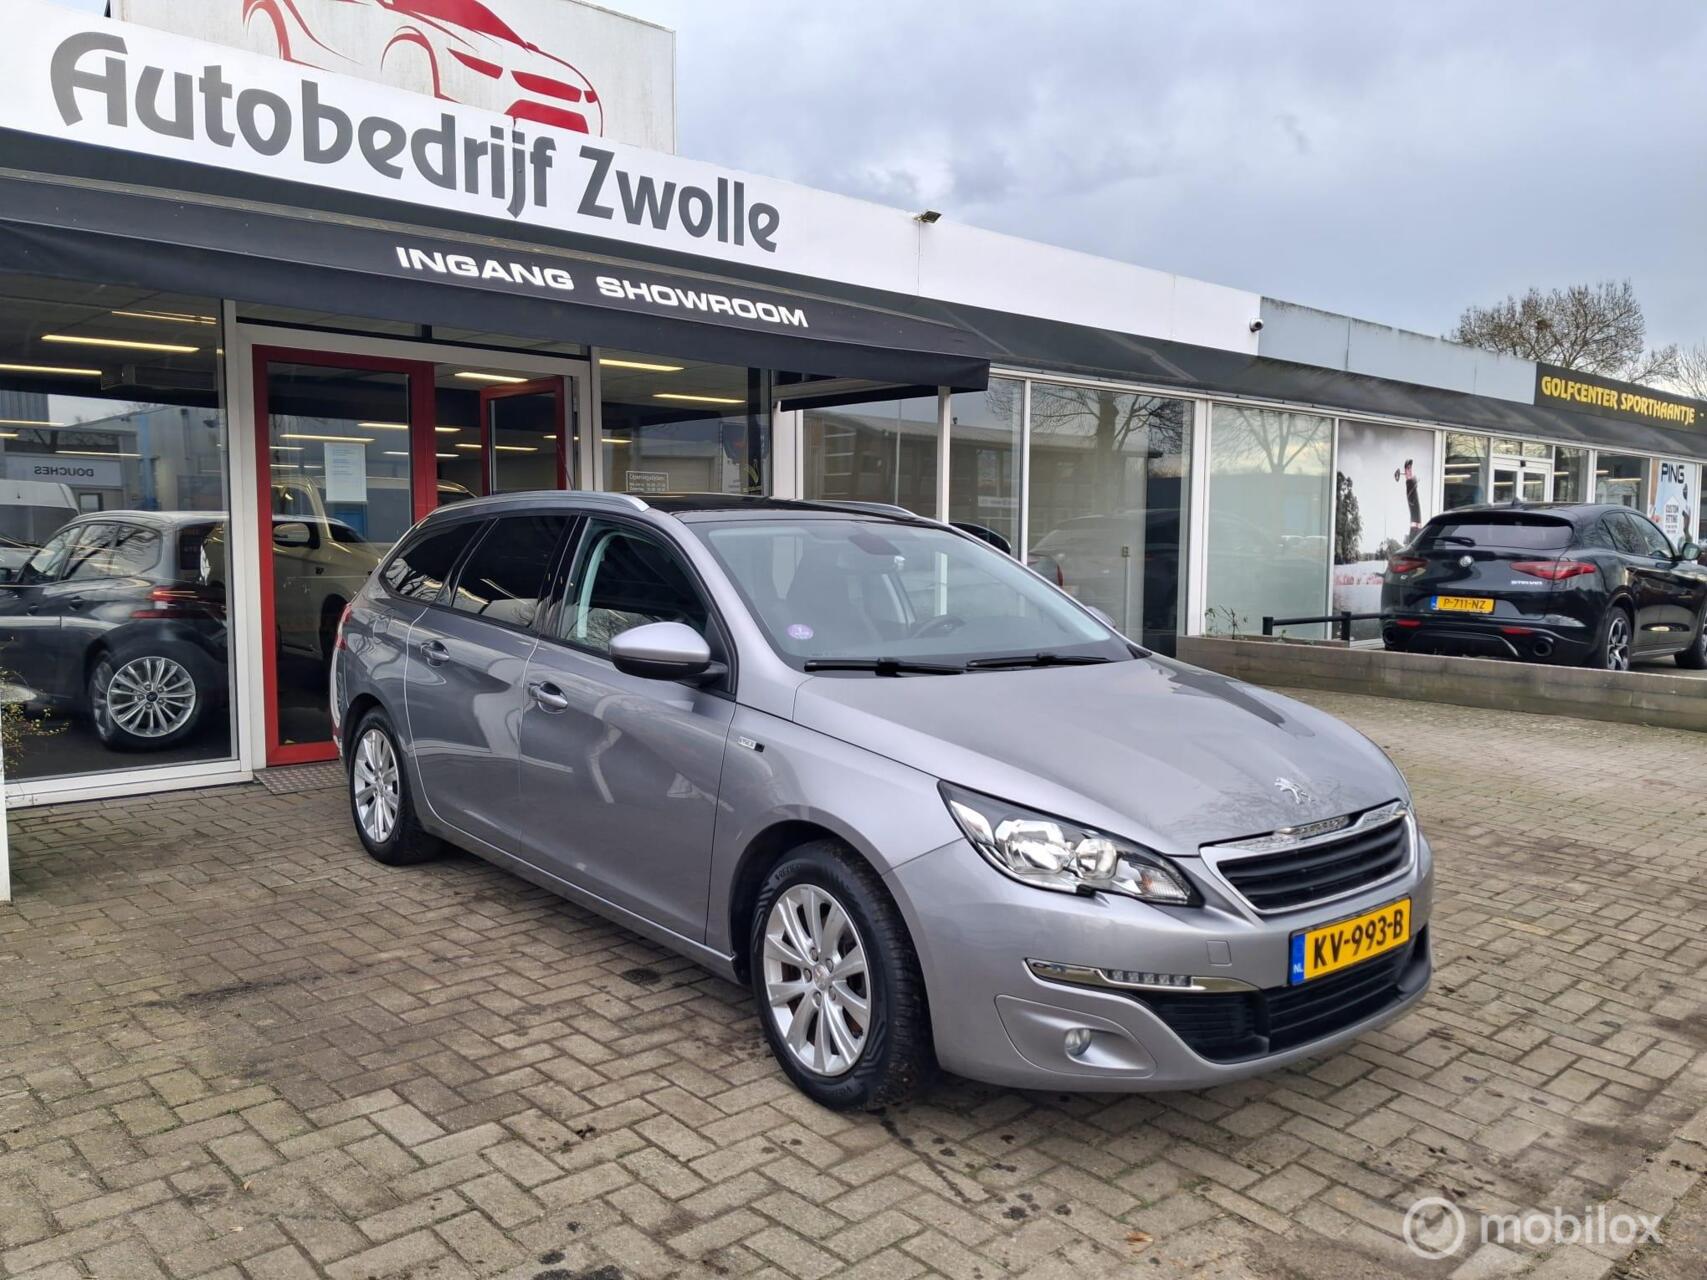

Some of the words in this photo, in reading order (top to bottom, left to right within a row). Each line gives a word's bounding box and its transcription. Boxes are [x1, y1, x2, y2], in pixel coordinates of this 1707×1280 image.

[49, 31, 555, 219] Autobedrijf
[577, 145, 781, 254] Zwolle
[396, 246, 575, 290] INGANG
[596, 275, 809, 328] SHOWROOM
[1541, 376, 1618, 411] GOLFCENTER
[1620, 392, 1696, 426] SPORTHAANTJE
[1661, 463, 1685, 484] PING
[1443, 599, 1486, 610] P-711-NZ
[1313, 909, 1404, 970] KV-993-B
[1293, 963, 1304, 974] NL
